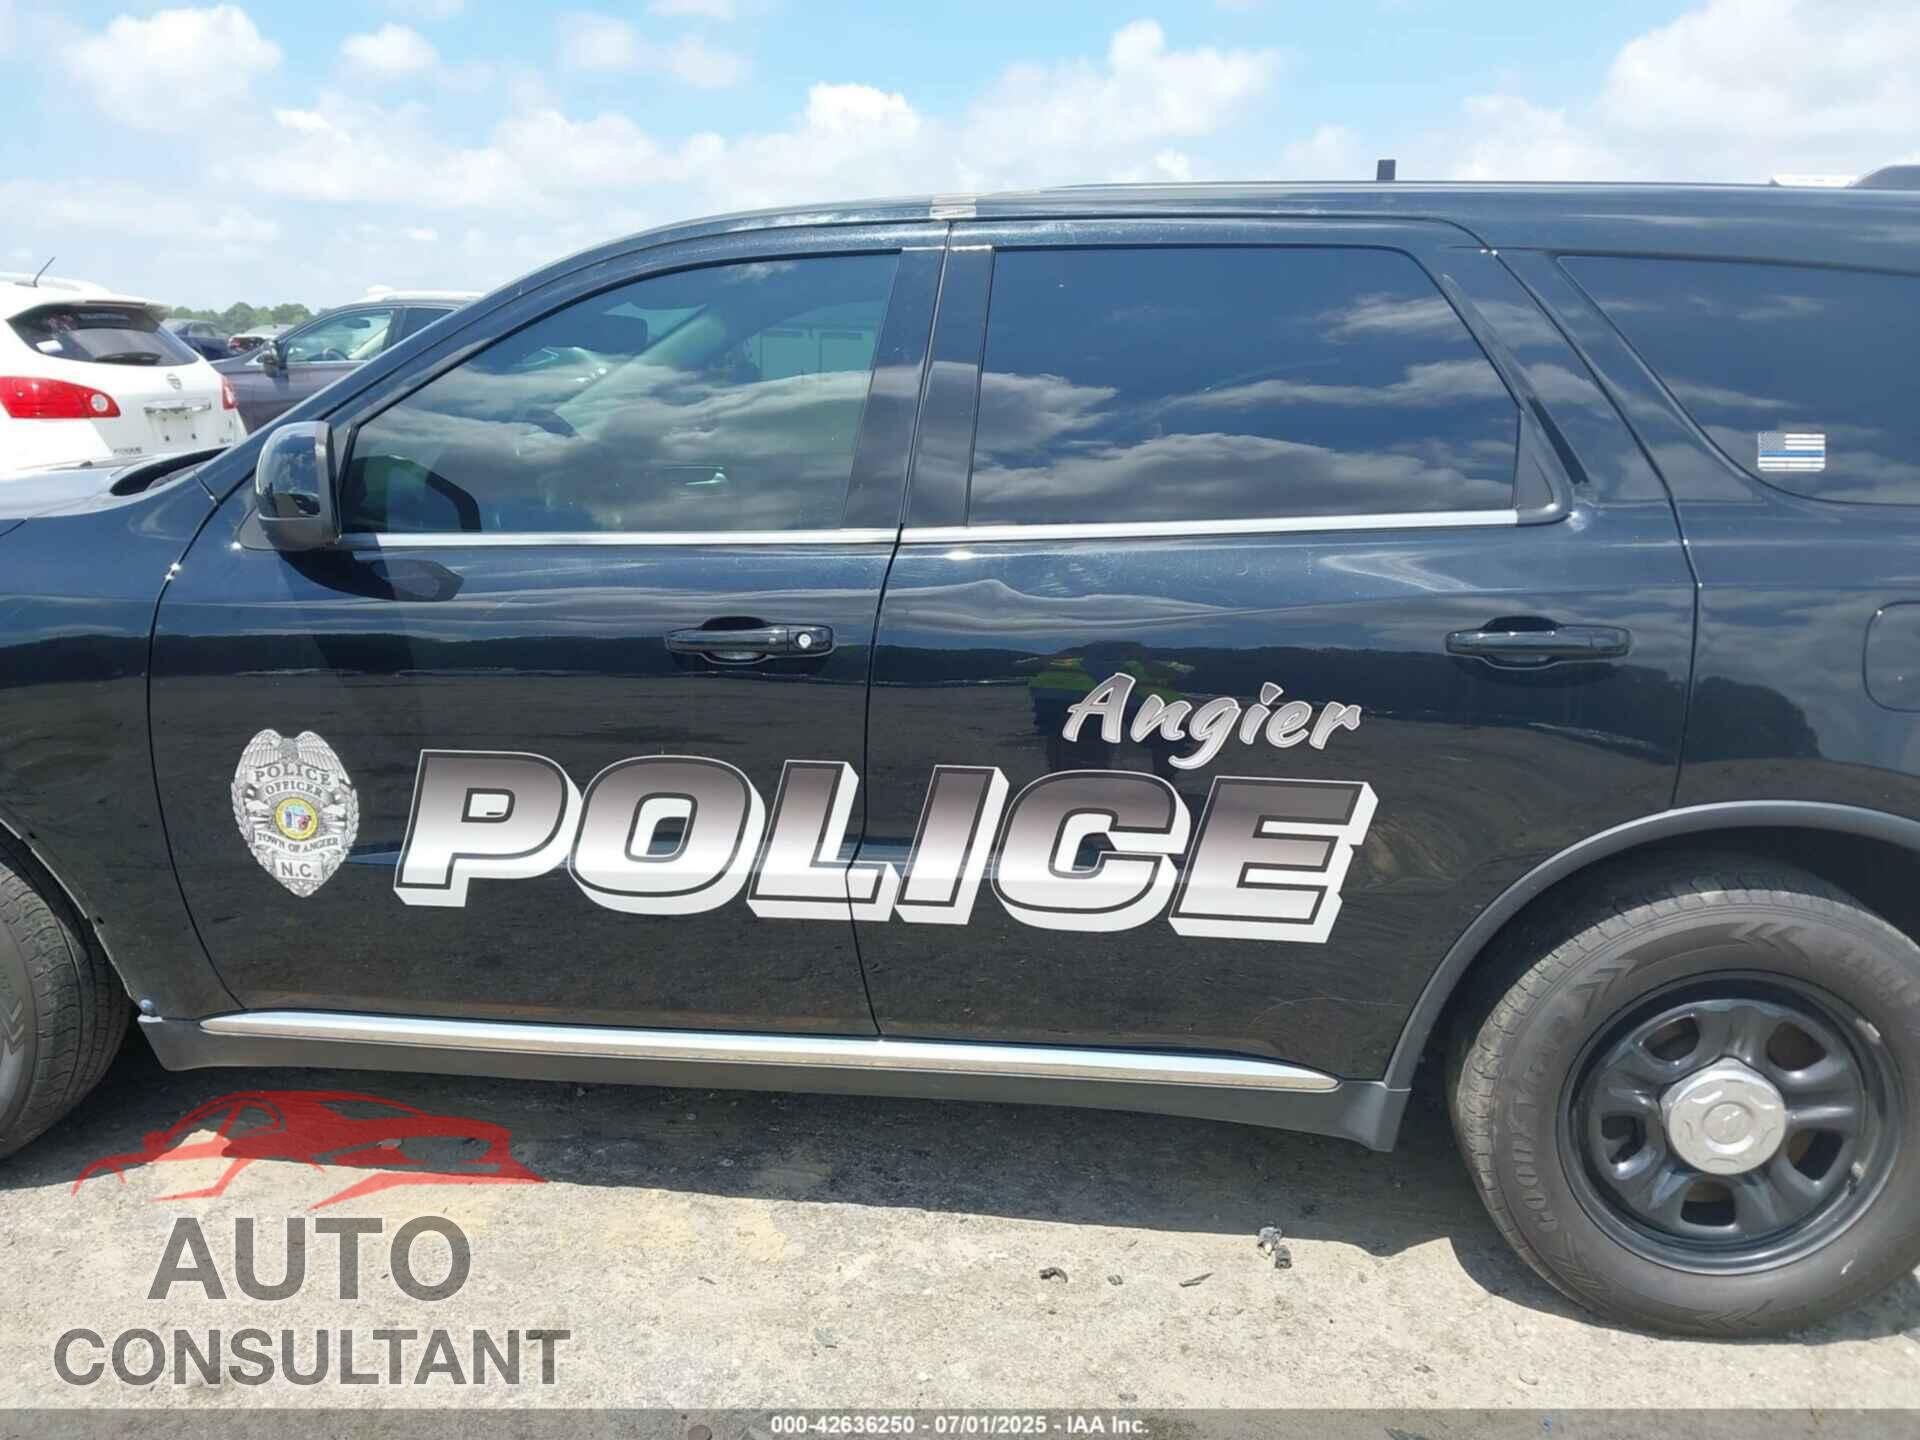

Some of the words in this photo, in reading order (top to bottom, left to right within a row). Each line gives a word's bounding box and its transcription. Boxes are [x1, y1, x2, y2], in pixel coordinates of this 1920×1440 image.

[1062, 672, 1361, 770] Angier
[254, 761, 332, 787] POLICE
[264, 780, 323, 798] OFFICER
[256, 832, 286, 850] TOWN
[288, 841, 300, 853] OF
[393, 748, 1379, 944] POLICE
[281, 861, 318, 879] N.C.
